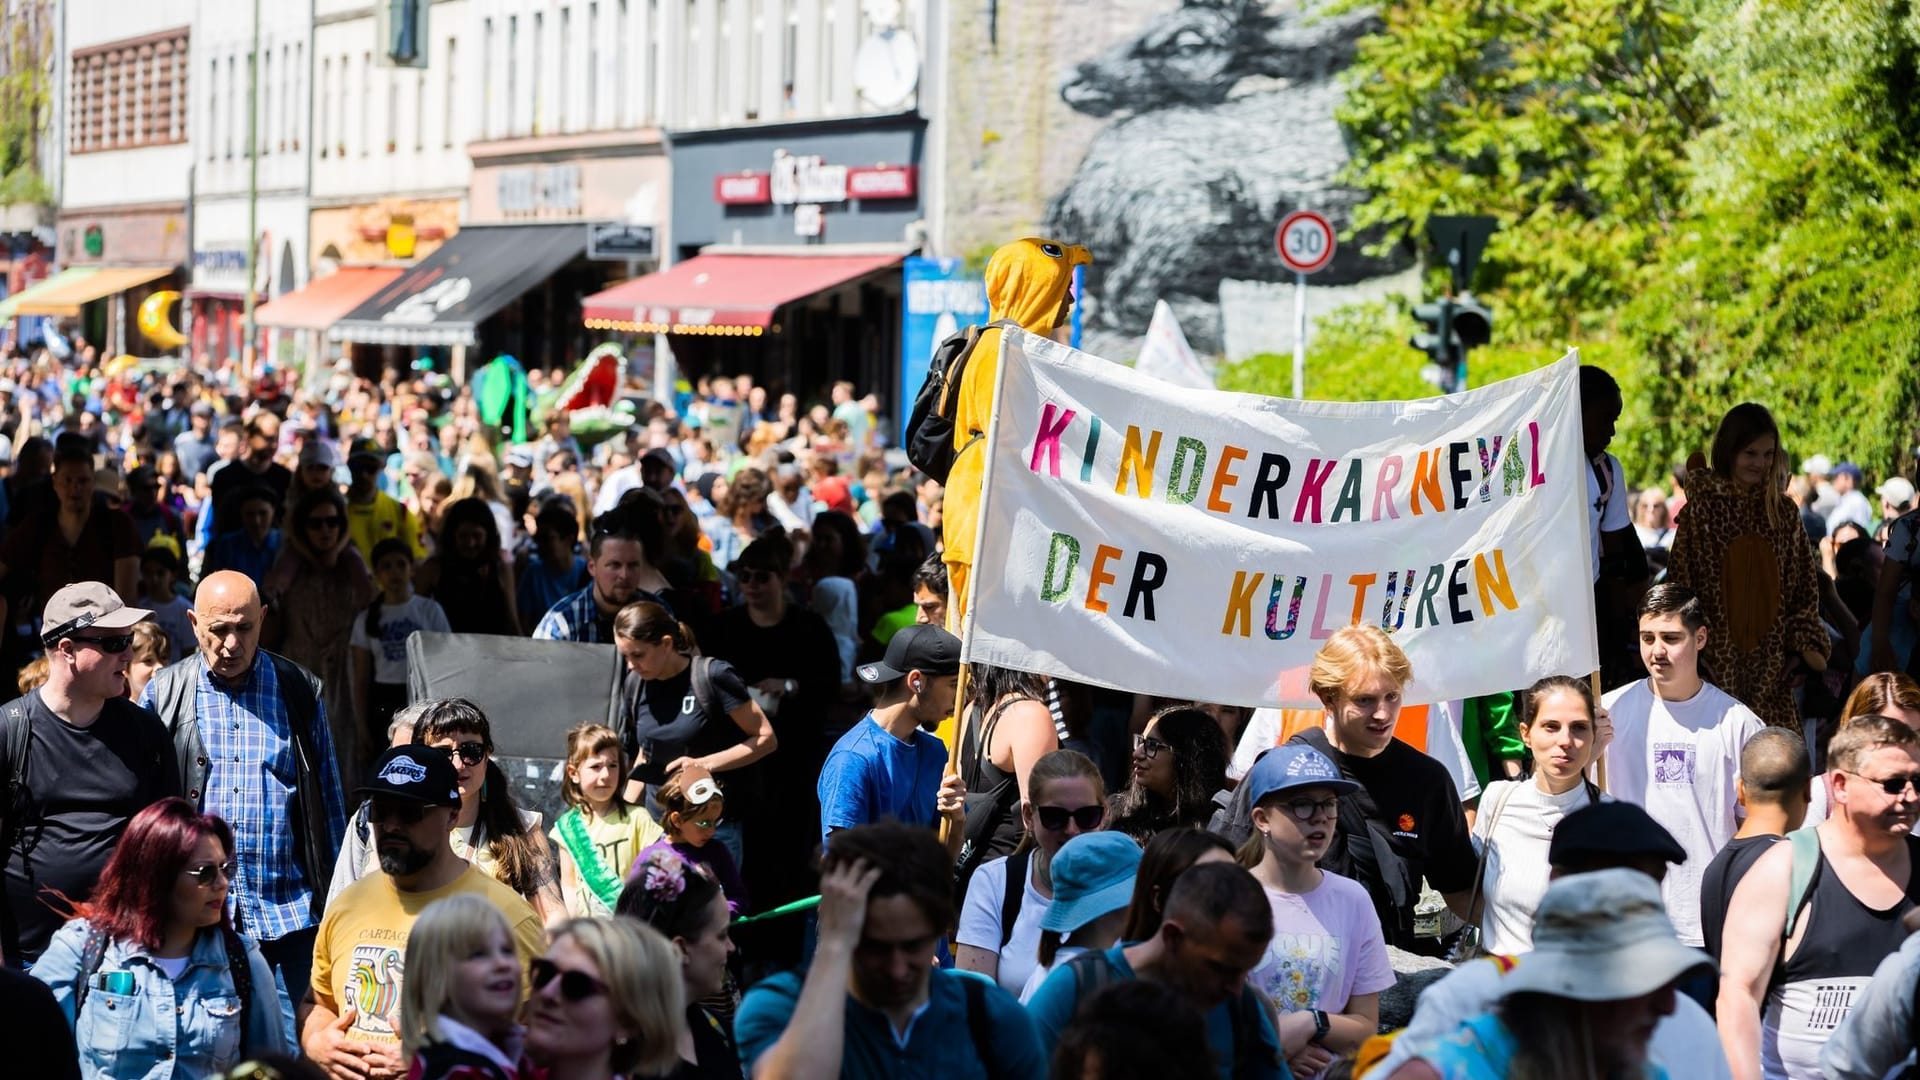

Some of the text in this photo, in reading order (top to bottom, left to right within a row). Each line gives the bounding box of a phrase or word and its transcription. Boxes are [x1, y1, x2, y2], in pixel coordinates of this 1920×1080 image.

[1290, 228, 1322, 255] 30
[1030, 403, 1546, 523] KINDERKARNEVAL
[1040, 531, 1520, 640] DER KULTUREN
[1286, 752, 1308, 777] NEW
[359, 928, 407, 941] CARTAG
